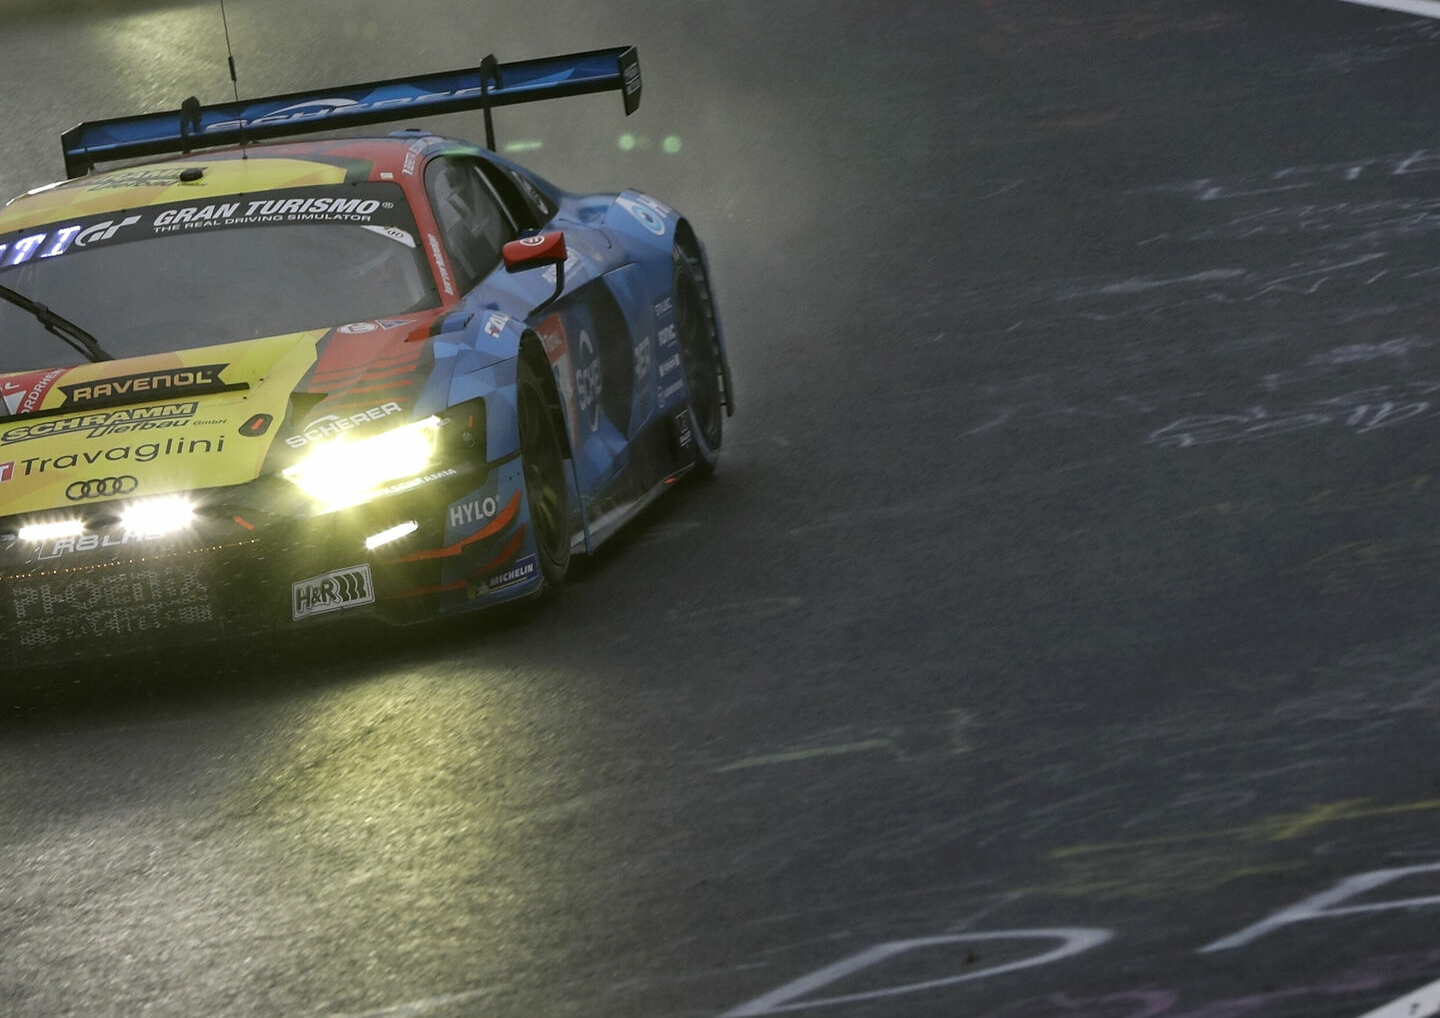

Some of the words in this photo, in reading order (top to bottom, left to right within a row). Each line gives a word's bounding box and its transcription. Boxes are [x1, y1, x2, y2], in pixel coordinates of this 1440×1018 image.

[152, 201, 241, 227] GRAN
[245, 197, 380, 216] TURISMO
[153, 222, 181, 233] THE
[185, 219, 222, 229] REAL
[225, 214, 284, 225] DRIVING
[287, 212, 371, 222] SIMULATOR
[72, 370, 213, 402] RAVENOL
[1, 402, 199, 443] SCHRAMM
[285, 401, 403, 449] SCHERER
[21, 435, 225, 476] Travaglini
[448, 496, 497, 527] HYLO
[489, 562, 534, 587] MICHELIN
[295, 578, 339, 612] H&R
